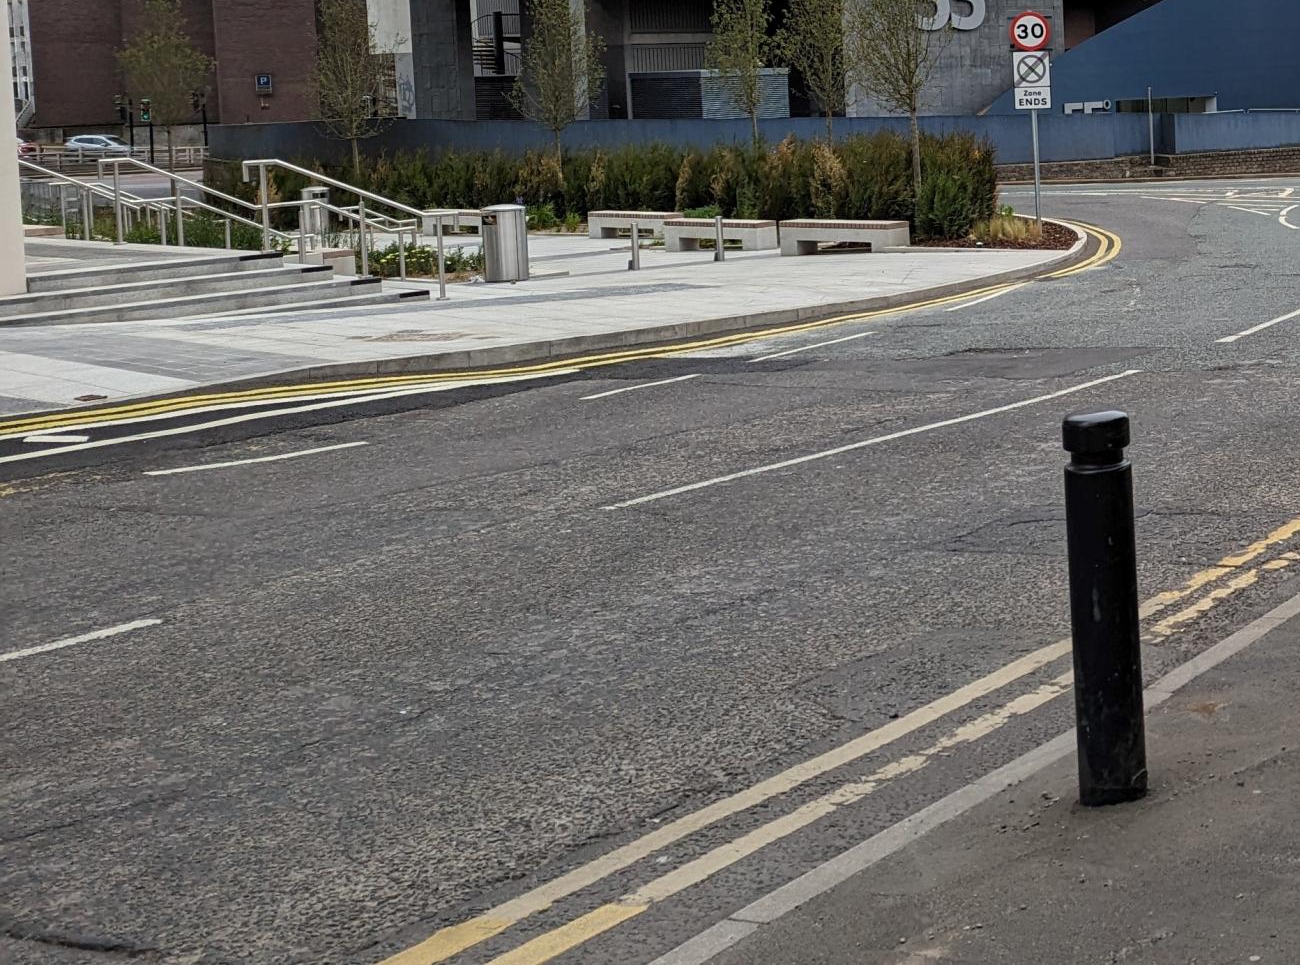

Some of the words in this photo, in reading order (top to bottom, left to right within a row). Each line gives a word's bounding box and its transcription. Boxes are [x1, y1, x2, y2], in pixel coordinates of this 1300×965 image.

[1016, 23, 1044, 40] 30
[260, 76, 267, 85] P
[1023, 89, 1042, 97] Zone
[1018, 98, 1048, 106] ENDS
